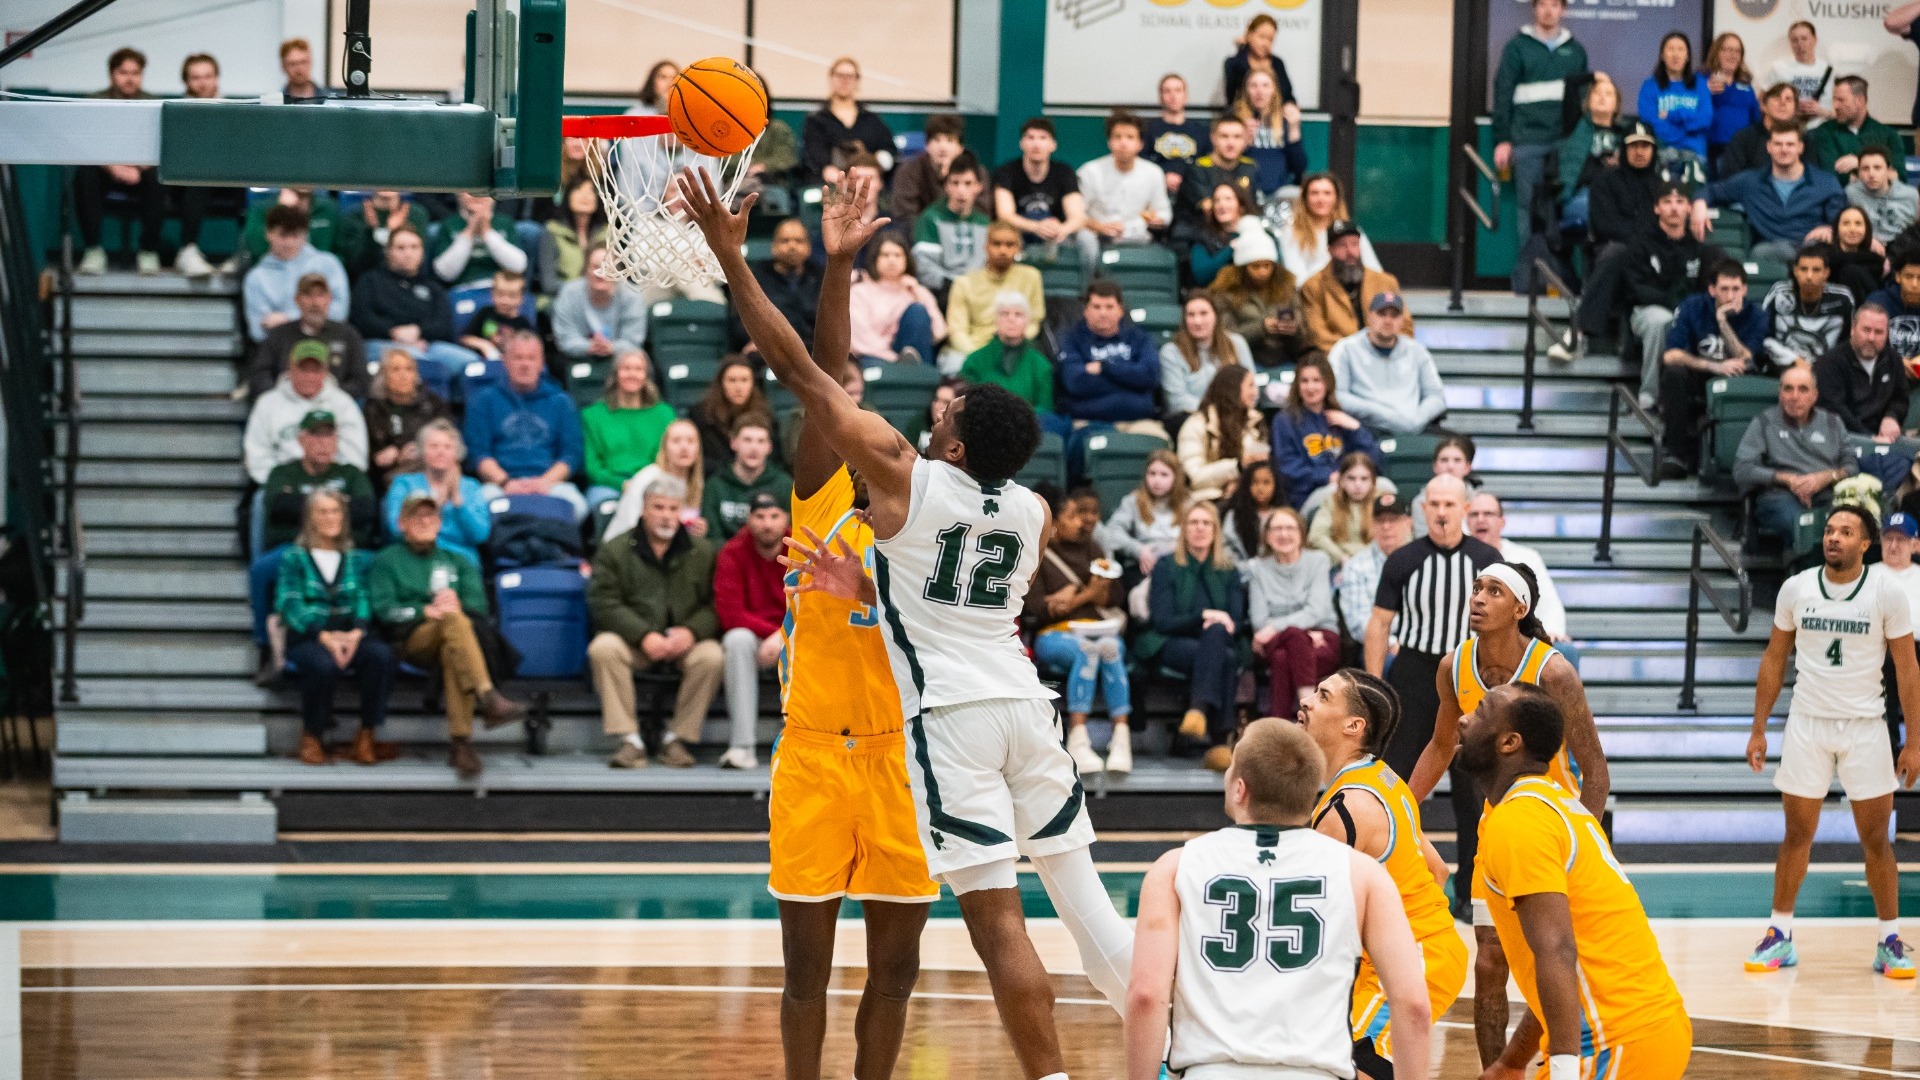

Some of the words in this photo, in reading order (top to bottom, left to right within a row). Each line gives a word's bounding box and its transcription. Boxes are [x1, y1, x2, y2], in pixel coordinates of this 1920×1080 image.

[923, 521, 1025, 609] 12
[1801, 617, 1871, 634] MERCYHURST
[1825, 637, 1843, 667] 4
[1200, 873, 1327, 974] 35
